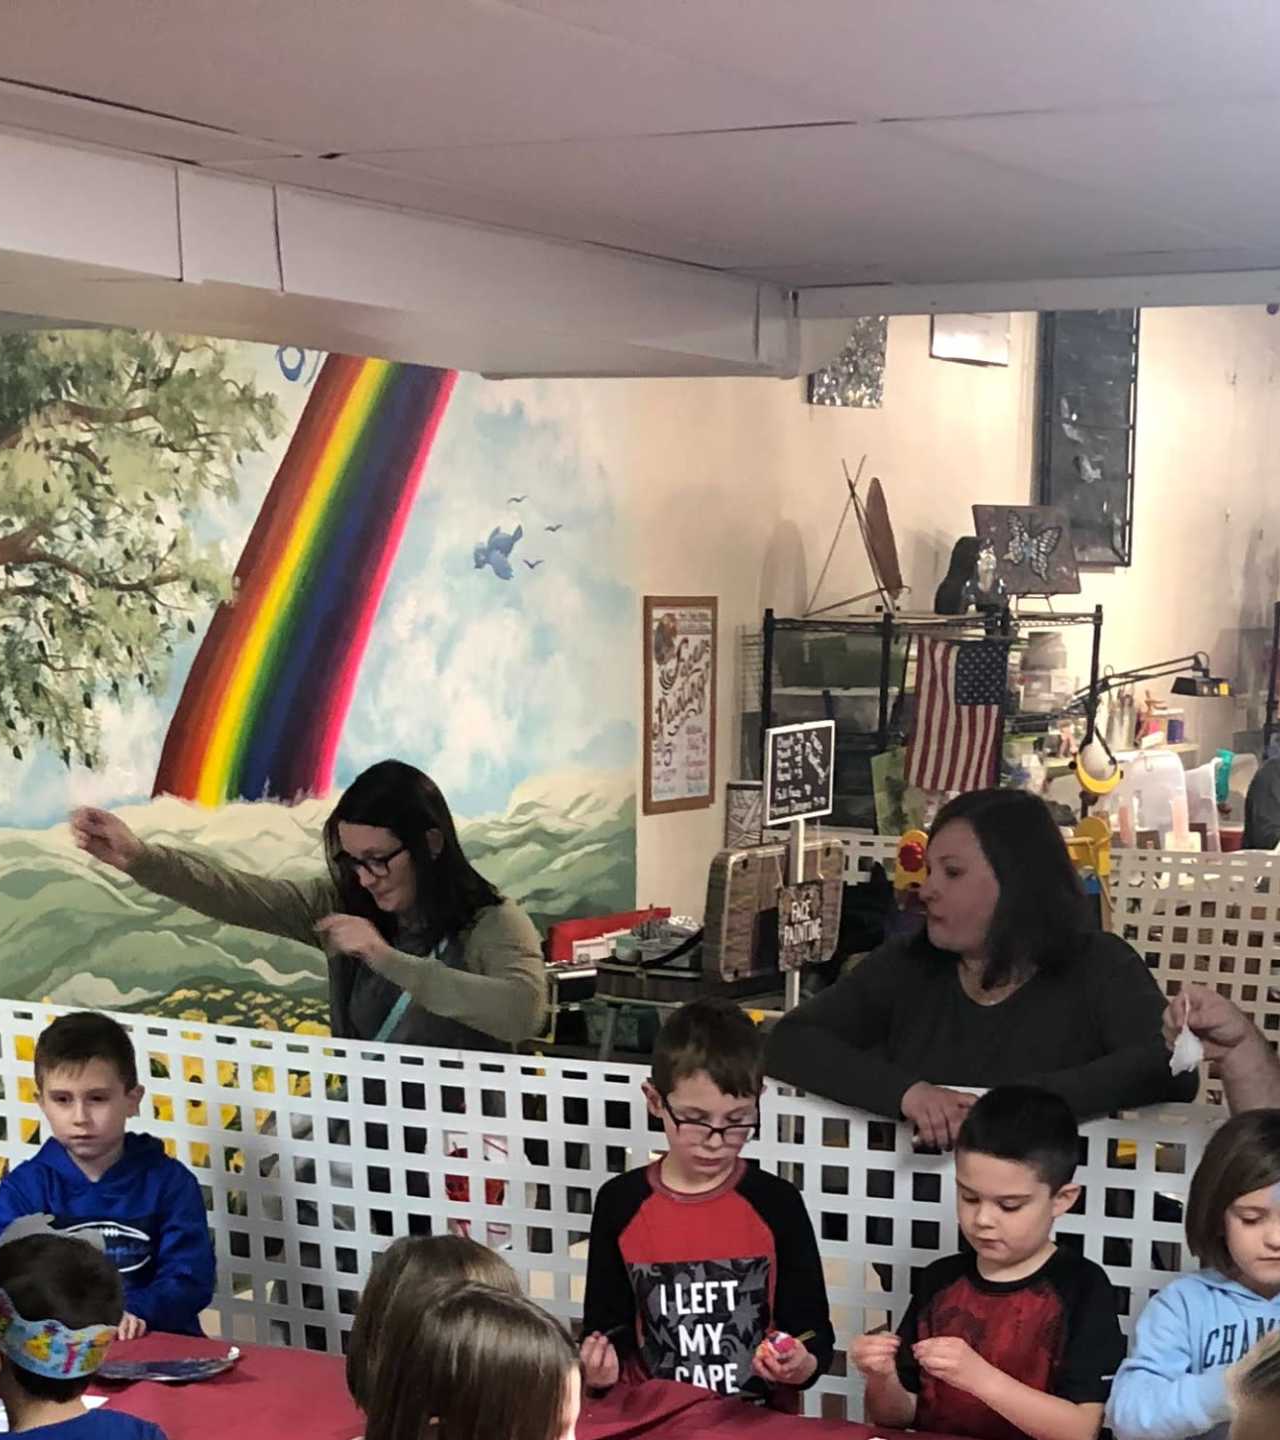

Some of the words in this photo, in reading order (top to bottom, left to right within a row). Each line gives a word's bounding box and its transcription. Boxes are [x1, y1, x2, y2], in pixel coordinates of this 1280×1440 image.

[791, 900, 812, 923] FACE
[784, 917, 822, 947] PAINTING
[660, 1283, 669, 1316] I
[675, 1280, 738, 1314] LEFT
[678, 1322, 725, 1357] MY
[675, 1362, 741, 1394] CAPE
